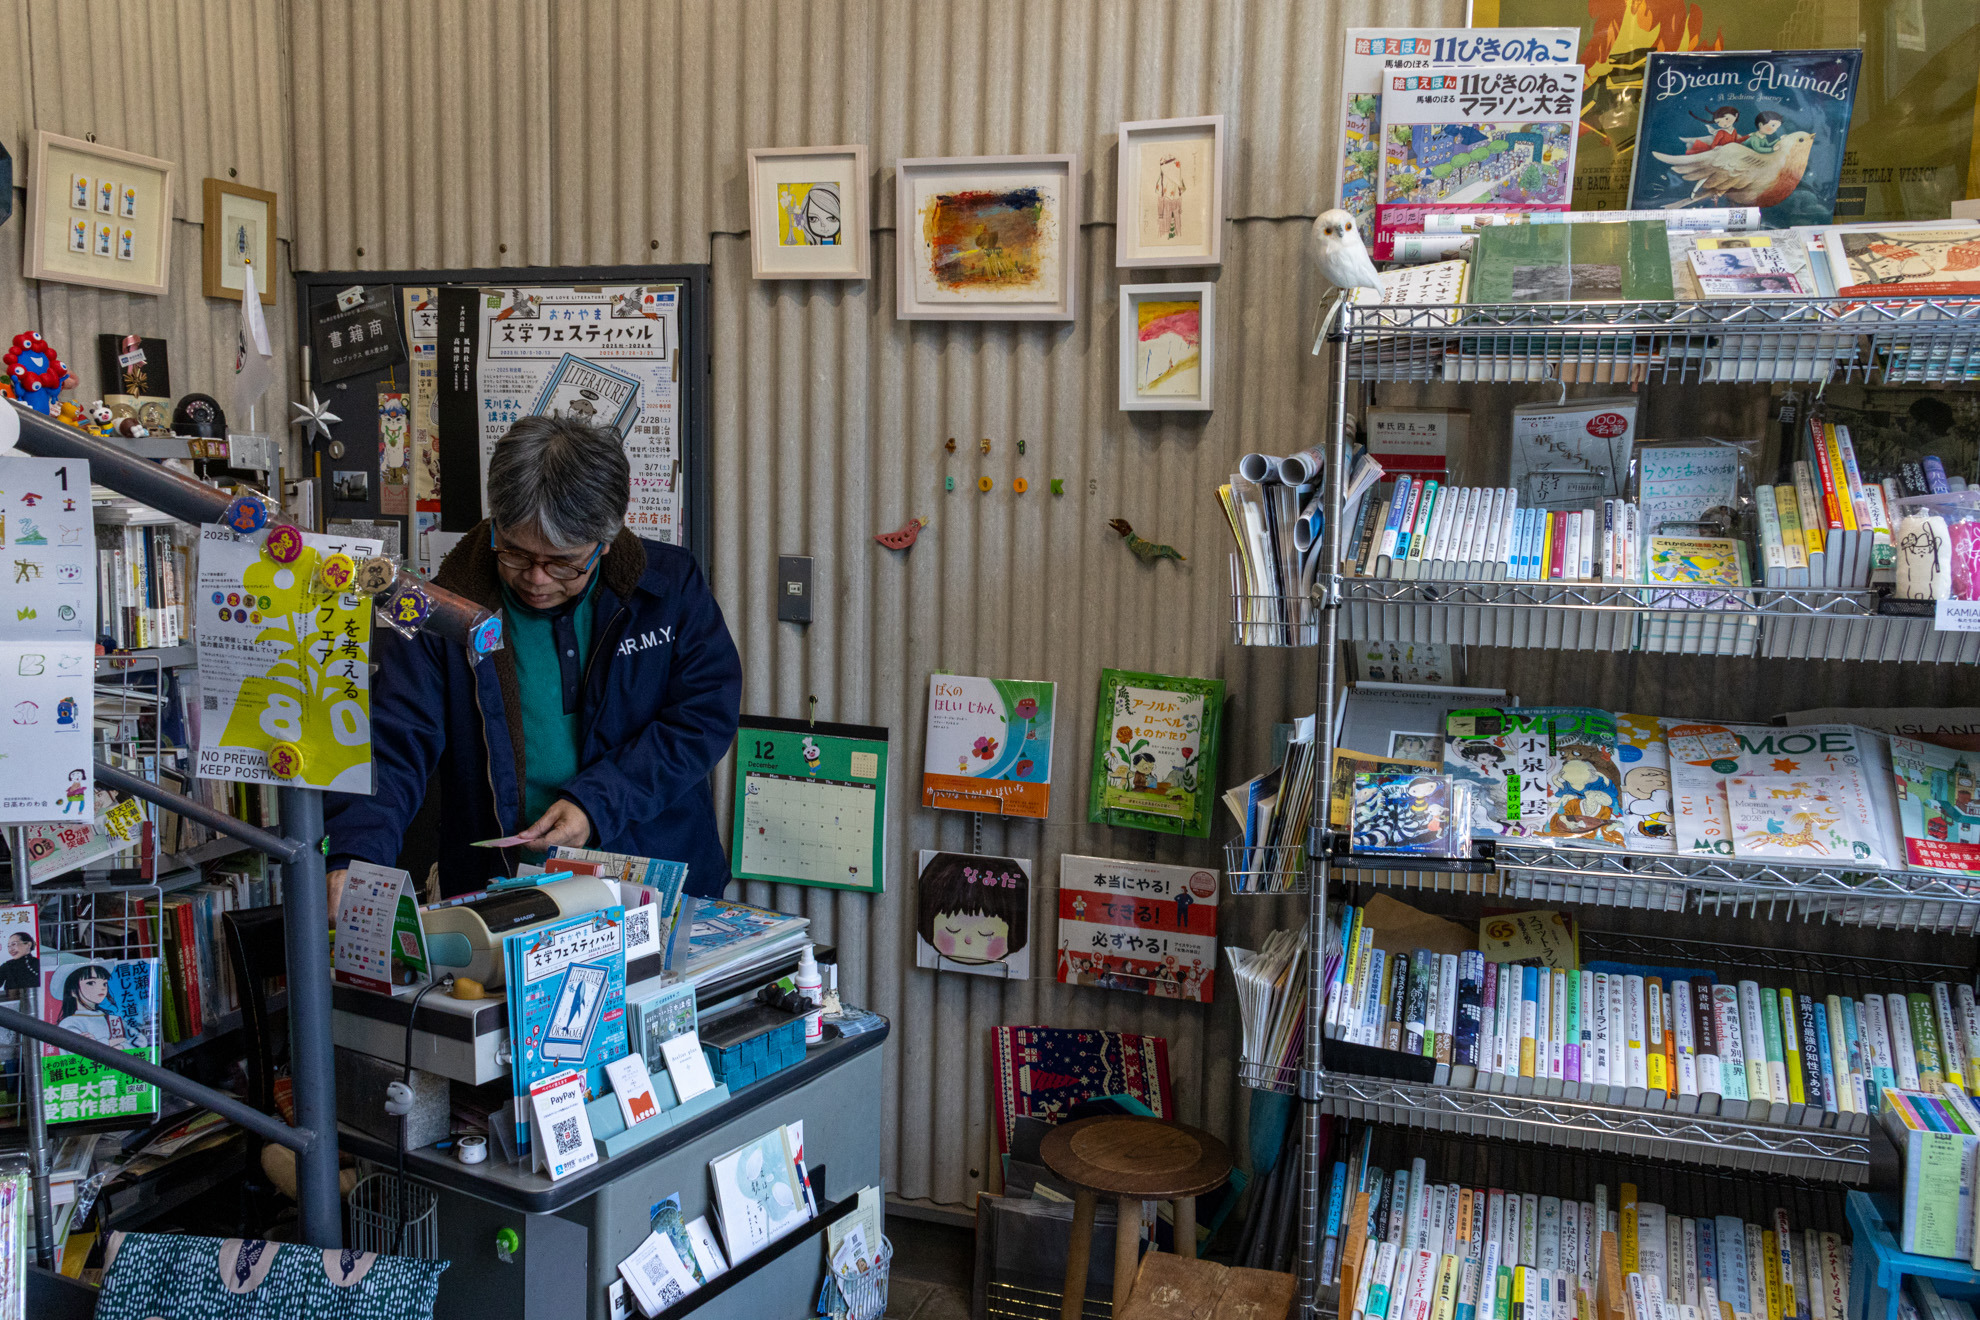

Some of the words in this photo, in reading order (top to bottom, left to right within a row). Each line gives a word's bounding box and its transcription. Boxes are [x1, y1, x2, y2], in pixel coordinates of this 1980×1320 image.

[1355, 38, 1431, 55] 絵巻えほん
[1433, 37, 1572, 63] 11ぴきのねこ
[1393, 75, 1457, 91] 絵巻えほん
[1460, 73, 1575, 95] 11ぴきのねこ
[1656, 66, 1741, 101] Dream
[1748, 61, 1848, 100] Animals
[1416, 95, 1455, 103] 馬場のぼる
[1459, 94, 1574, 115] マラソン大会
[1861, 168, 1893, 183] TELLY
[1899, 167, 1938, 182] VISION
[549, 308, 602, 321] おかやま
[328, 318, 383, 348] 書籍商
[501, 322, 654, 343] 文学フェスティバル
[563, 365, 629, 405] LITERATURE
[484, 398, 522, 410] 天川栄人
[55, 466, 68, 491] 1
[204, 530, 230, 541] 2025
[1656, 539, 1729, 549] これからの建築入門
[935, 683, 963, 697] ぼくの
[1351, 688, 1389, 698] Robert
[1391, 690, 1442, 700] Coutelas
[934, 698, 963, 712] ほしい
[968, 701, 997, 715] じかん
[1144, 715, 1185, 728] ローベル
[1502, 714, 1616, 738] MOE
[1134, 727, 1188, 742] ものがたり
[1735, 733, 1855, 755] MOE
[201, 751, 220, 762] NO
[223, 753, 271, 767] PREWA
[755, 740, 774, 760] 12
[199, 764, 231, 776] KEEP
[747, 761, 779, 770] December
[1519, 738, 1547, 816] 小泉八雲
[3, 800, 48, 808] 日高わのわ会
[1507, 775, 1520, 820] おばけの話
[1735, 800, 1768, 808] Moomin
[114, 806, 134, 828] 天下を
[122, 798, 143, 823] 成瀬は
[1740, 814, 1763, 823] 2026
[1751, 807, 1776, 816] Diary
[105, 807, 131, 842] 取りにいく
[1916, 839, 1948, 850] 英国の
[1094, 872, 1170, 895] 本当にやる!
[513, 912, 536, 924] SHARP
[1102, 902, 1160, 925] できる!
[1489, 923, 1515, 938] 65
[533, 931, 616, 968] 文学フェスティバル
[1092, 930, 1168, 956] 必ずやる!
[132, 960, 149, 1000] 成瀬は
[568, 968, 604, 986] LITERATURE
[115, 962, 139, 1048] 信じた道をいく
[1715, 1001, 1728, 1042] Otherlands
[1726, 1005, 1745, 1077] 素晴らしき別世界
[1800, 994, 1821, 1096] 読解力は最強の知性である
[43, 1078, 118, 1103] 本屋大賞
[550, 1090, 576, 1106] PayPay
[45, 1094, 138, 1120] 受賞作続編
[1328, 1173, 1343, 1233] おれのおばさん
[1393, 1179, 1406, 1240] 世界地図の下書き
[1685, 1231, 1695, 1292] ウイルスは動く遺伝子
